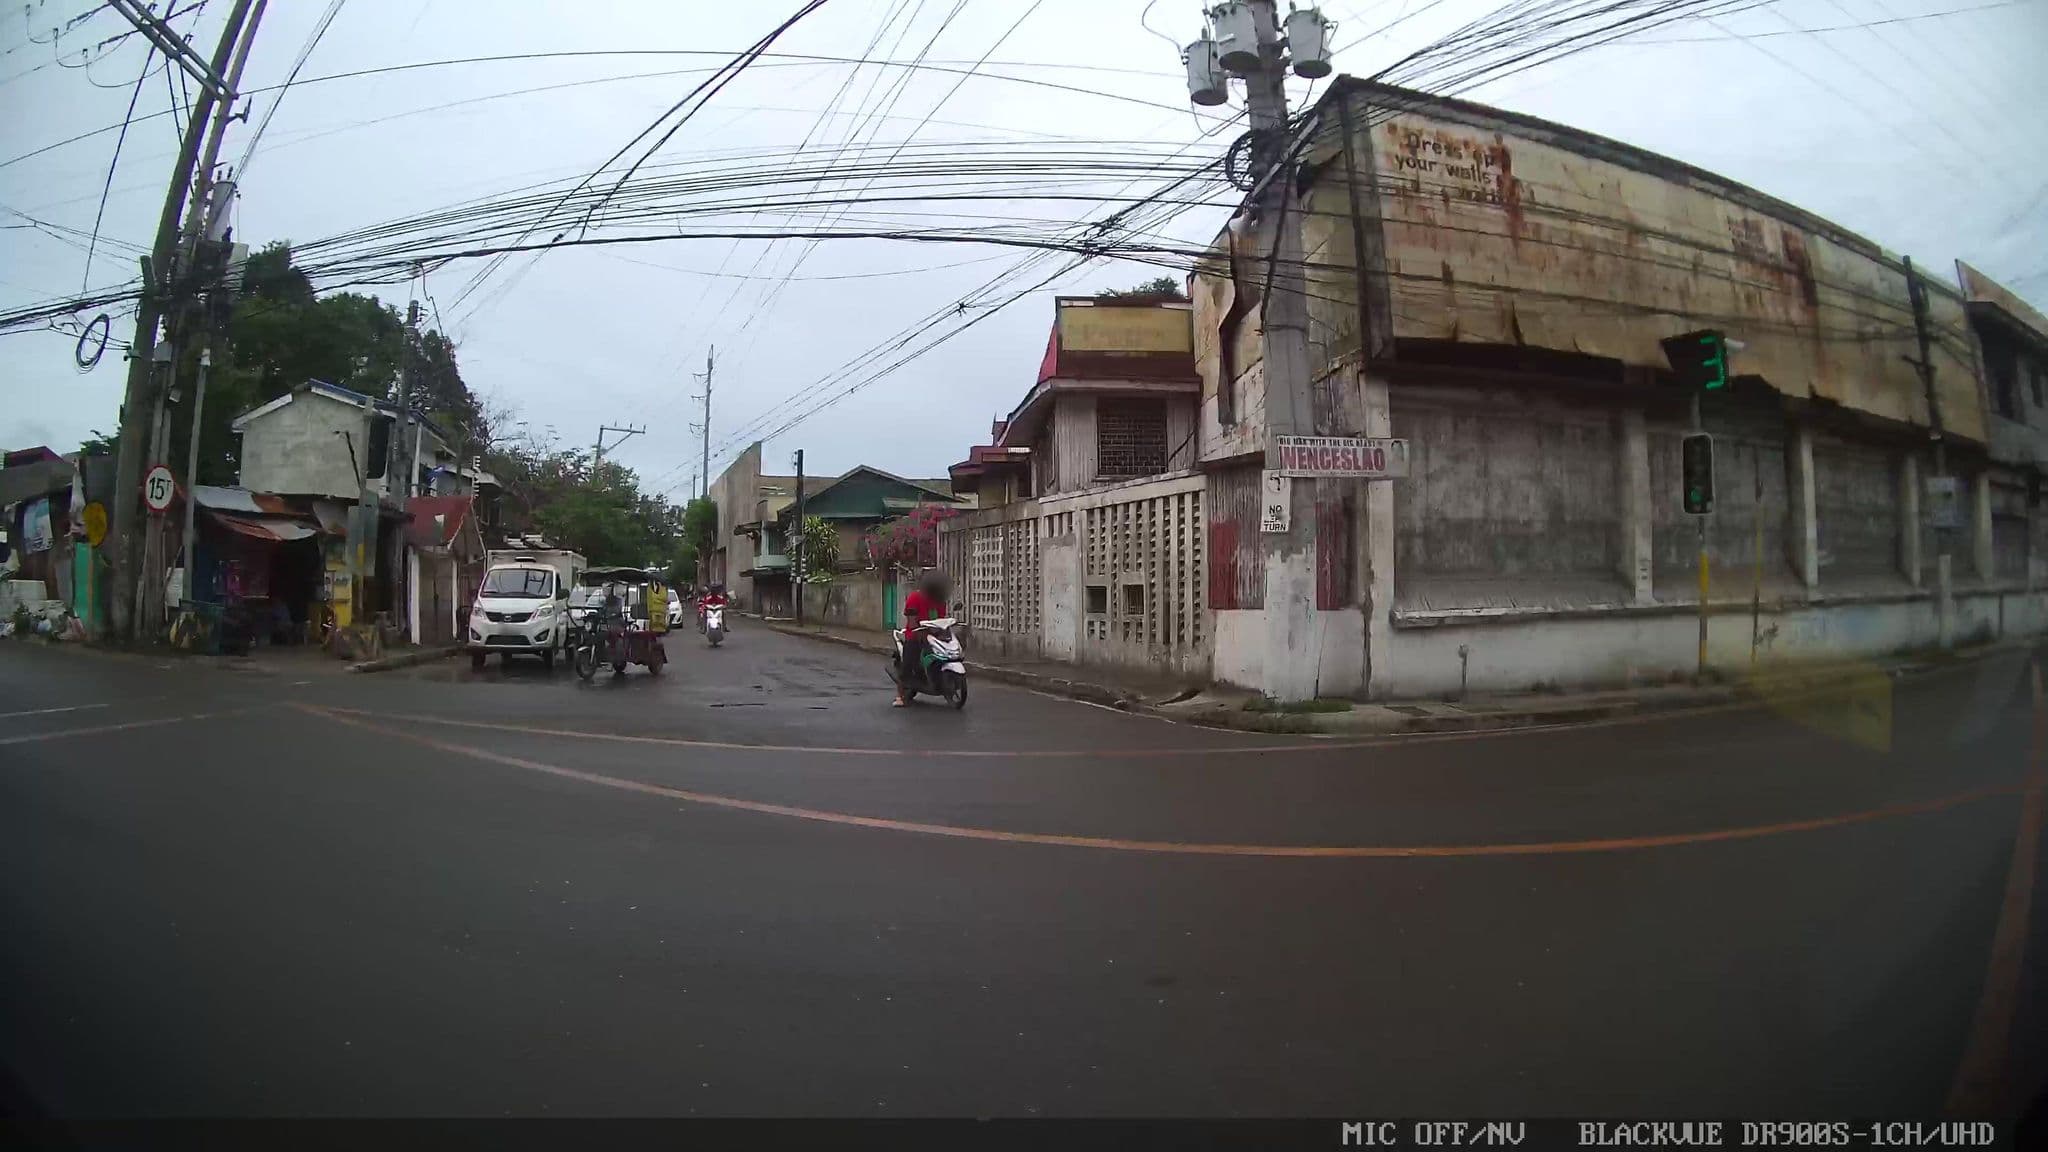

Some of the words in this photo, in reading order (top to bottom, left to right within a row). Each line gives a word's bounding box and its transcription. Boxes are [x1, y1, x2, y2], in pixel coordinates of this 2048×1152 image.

[1395, 154, 1437, 172] your
[1446, 163, 1491, 184] walls
[1699, 336, 1725, 390] 3
[1278, 446, 1386, 472] WENCESLAO
[1269, 504, 1283, 514] NO
[1263, 523, 1287, 532] TURN
